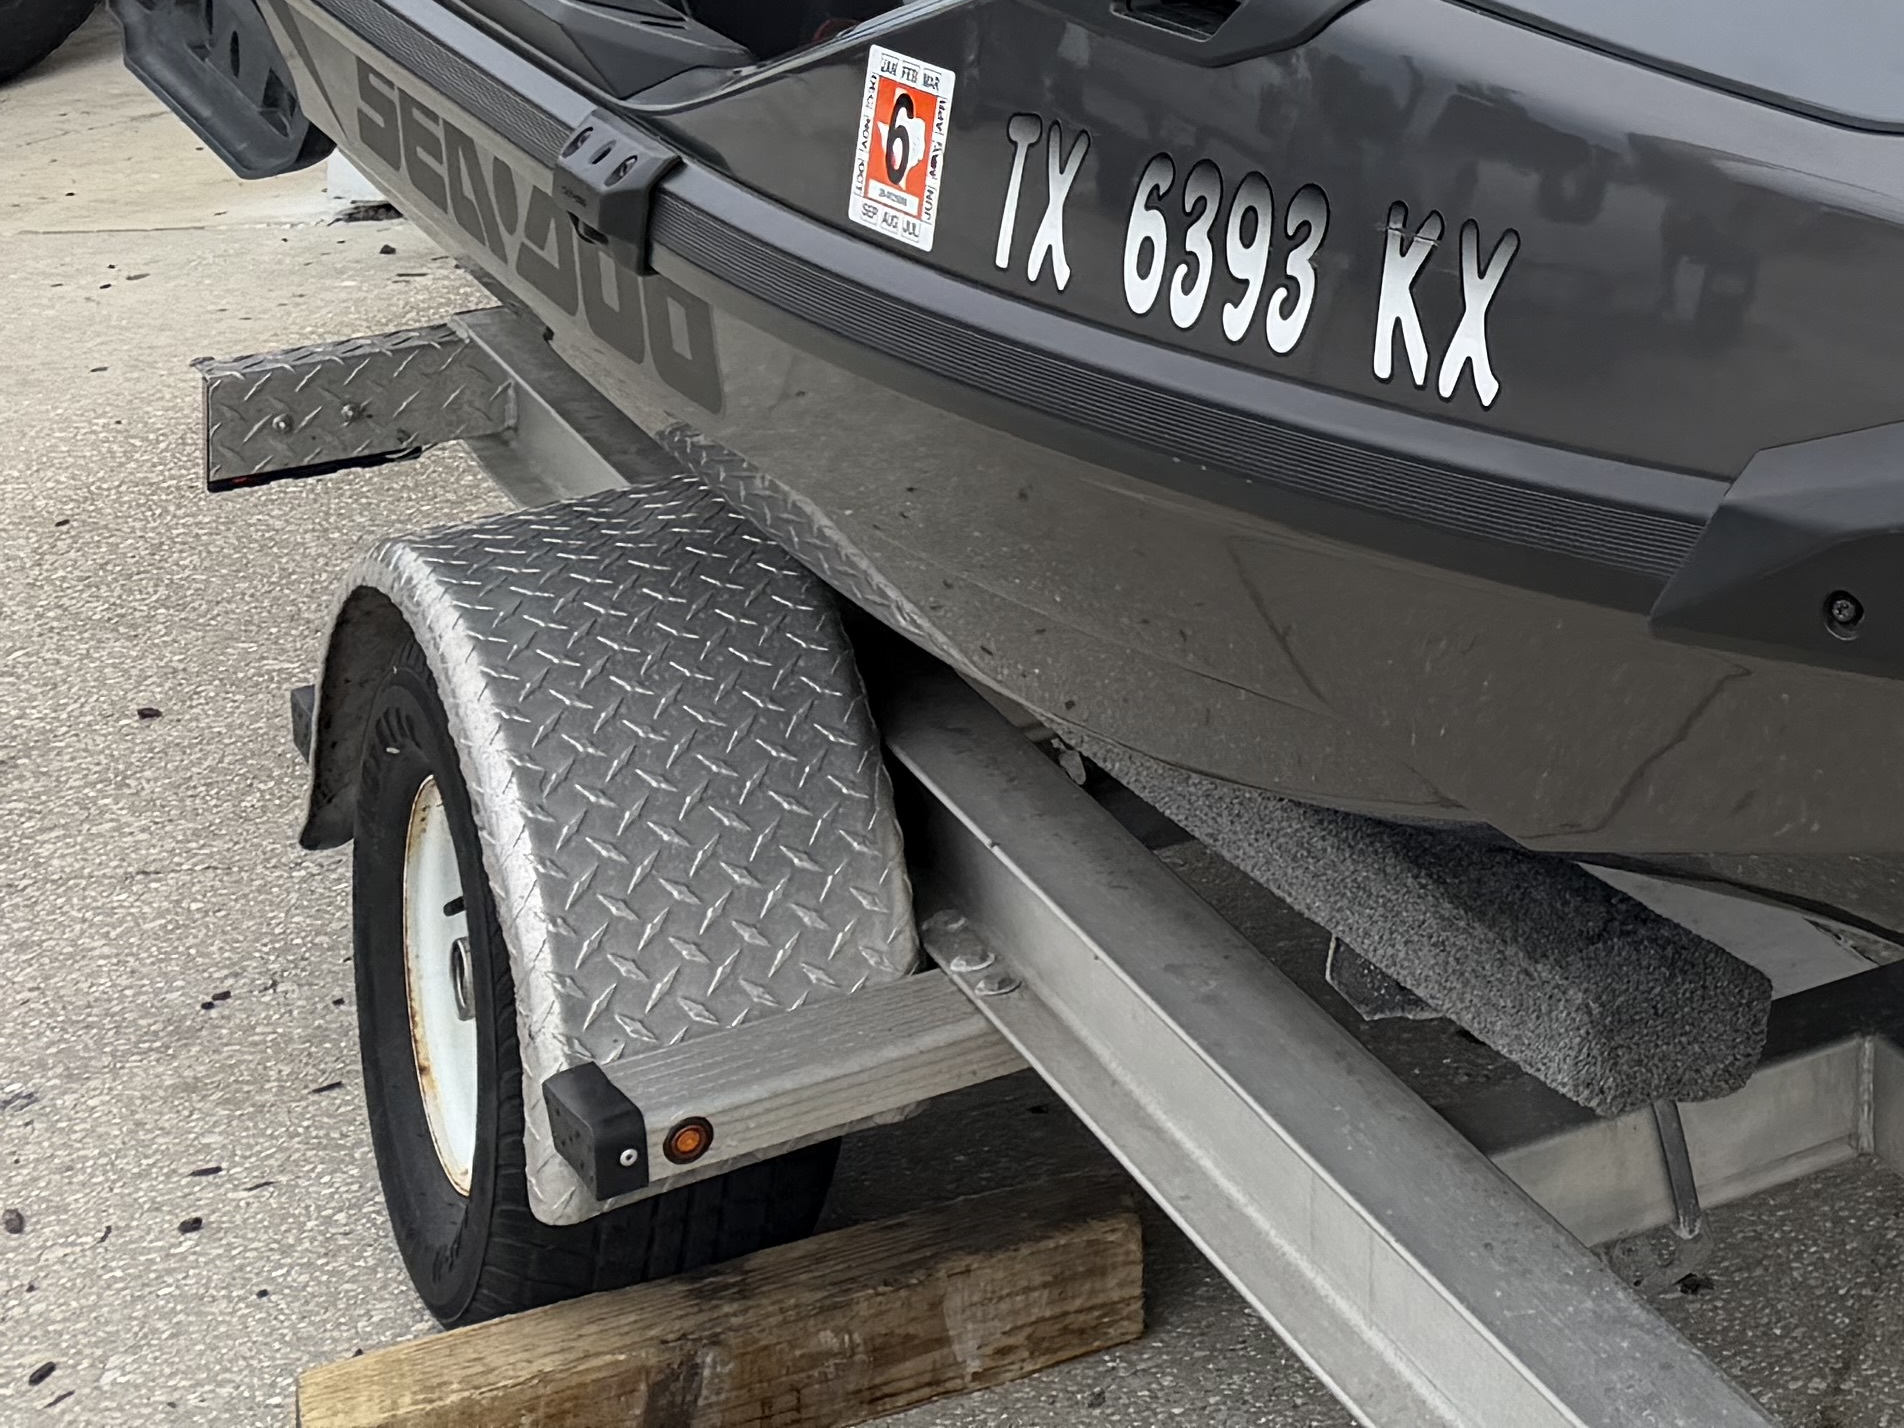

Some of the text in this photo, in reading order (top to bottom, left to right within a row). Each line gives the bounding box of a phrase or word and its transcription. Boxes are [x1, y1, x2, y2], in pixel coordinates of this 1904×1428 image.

[886, 92, 915, 186] 6
[881, 211, 899, 230] AUG
[923, 189, 935, 221] JUN
[995, 113, 1521, 408] TX 6393 KX
